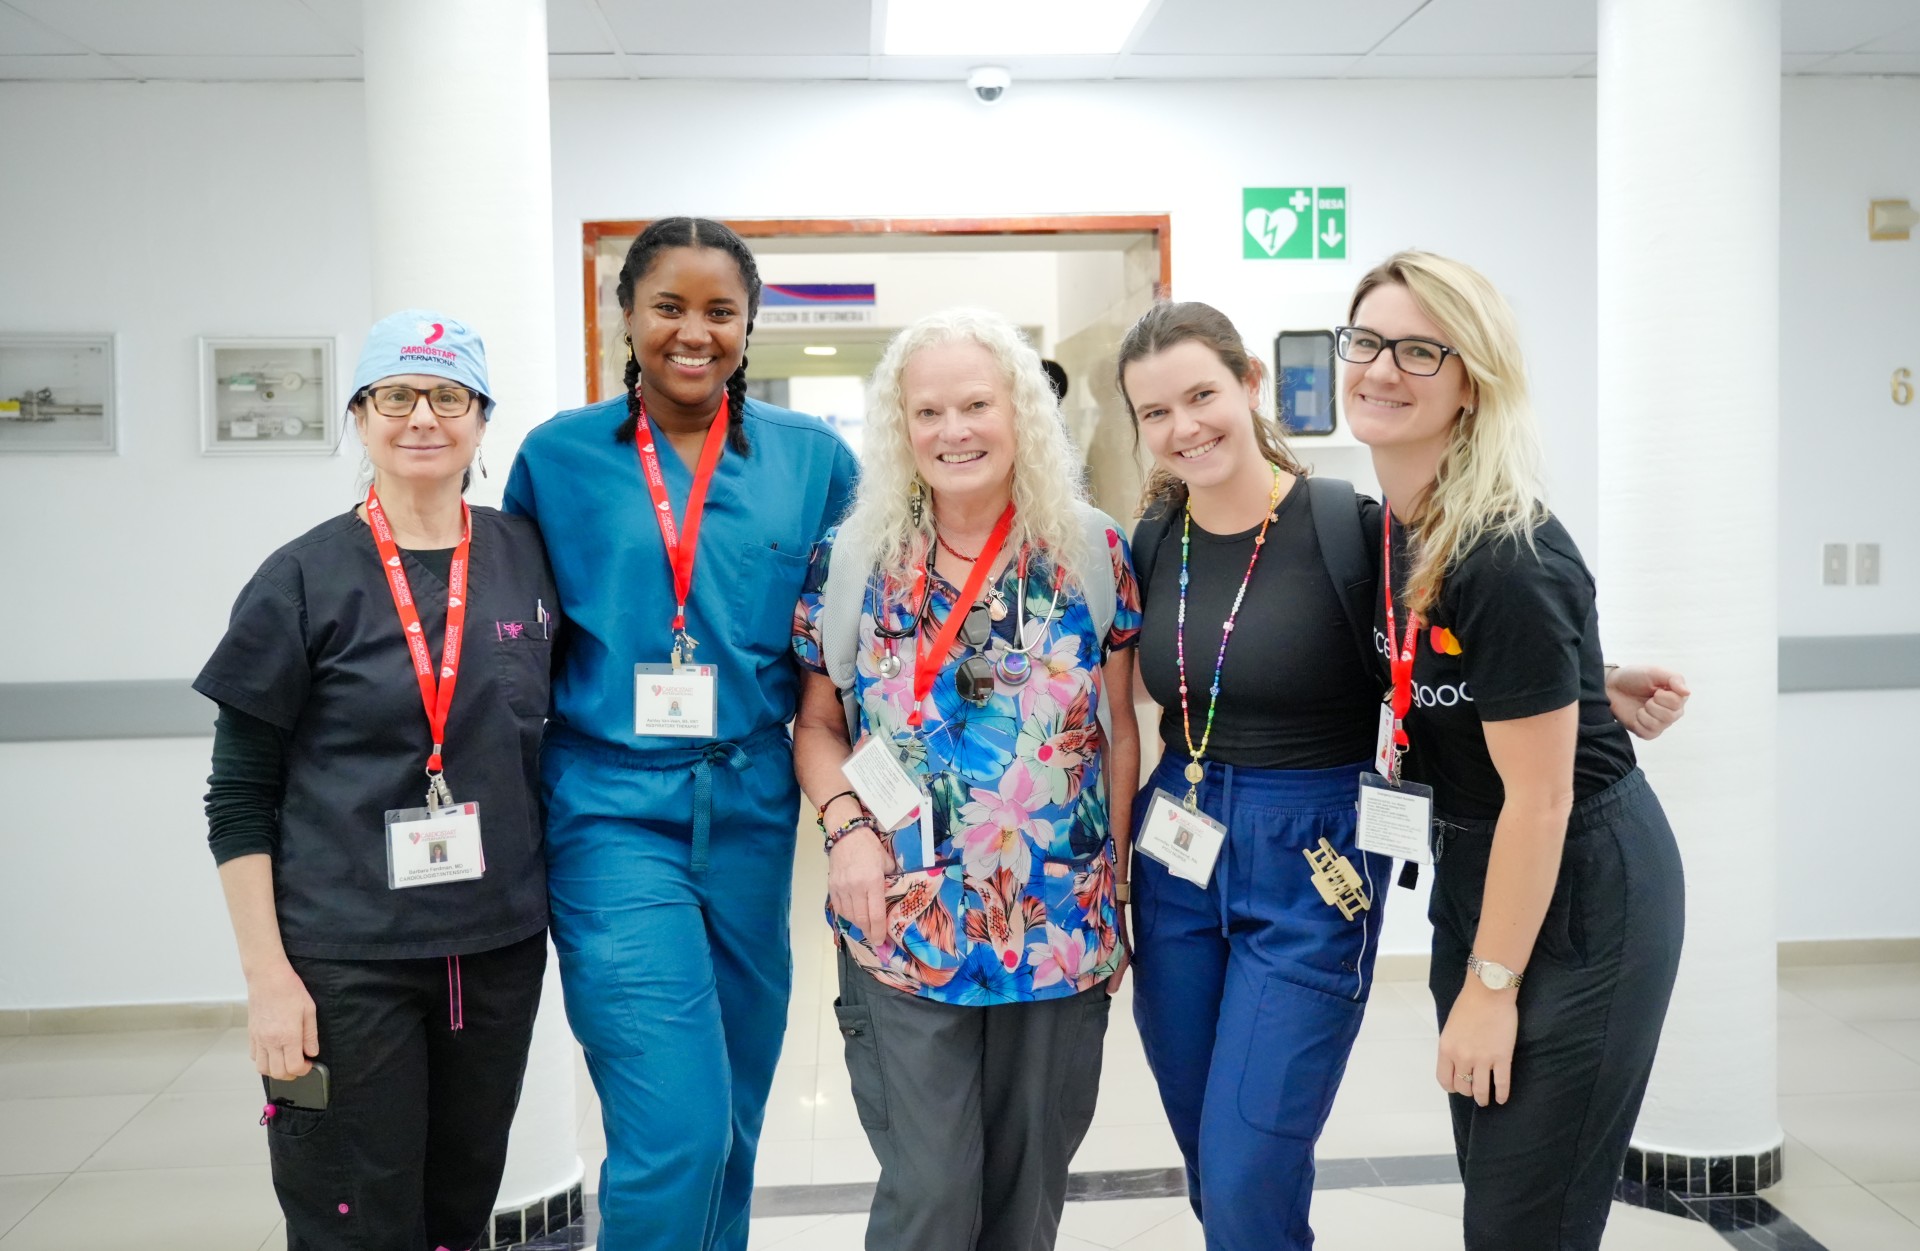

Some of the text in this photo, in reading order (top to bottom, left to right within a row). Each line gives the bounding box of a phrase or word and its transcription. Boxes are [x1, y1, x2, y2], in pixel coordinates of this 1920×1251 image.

[1319, 199, 1345, 210] DESA
[399, 354, 458, 369] INTERNATIONAL
[400, 345, 457, 361] CARDIOSTART
[1891, 367, 1914, 406] 6
[649, 454, 663, 486] CARDIOSTART
[370, 511, 385, 543] INTERNATIONAL
[374, 508, 391, 541] CARDIOSTART
[660, 512, 672, 548] INTERNATIONAL
[664, 512, 677, 547] CARDIOSTART
[390, 569, 405, 607] INTERNATIONAL
[395, 568, 412, 606] CARDIOSTART
[450, 559, 459, 595] CARDIOSTART
[410, 636, 424, 676] INTERNATIONAL
[415, 634, 430, 675] CARDIOSTART
[444, 624, 455, 665] CARDIOSTART
[450, 625, 459, 665] INTERNATIONAL
[421, 829, 456, 838] CARDIOSTART
